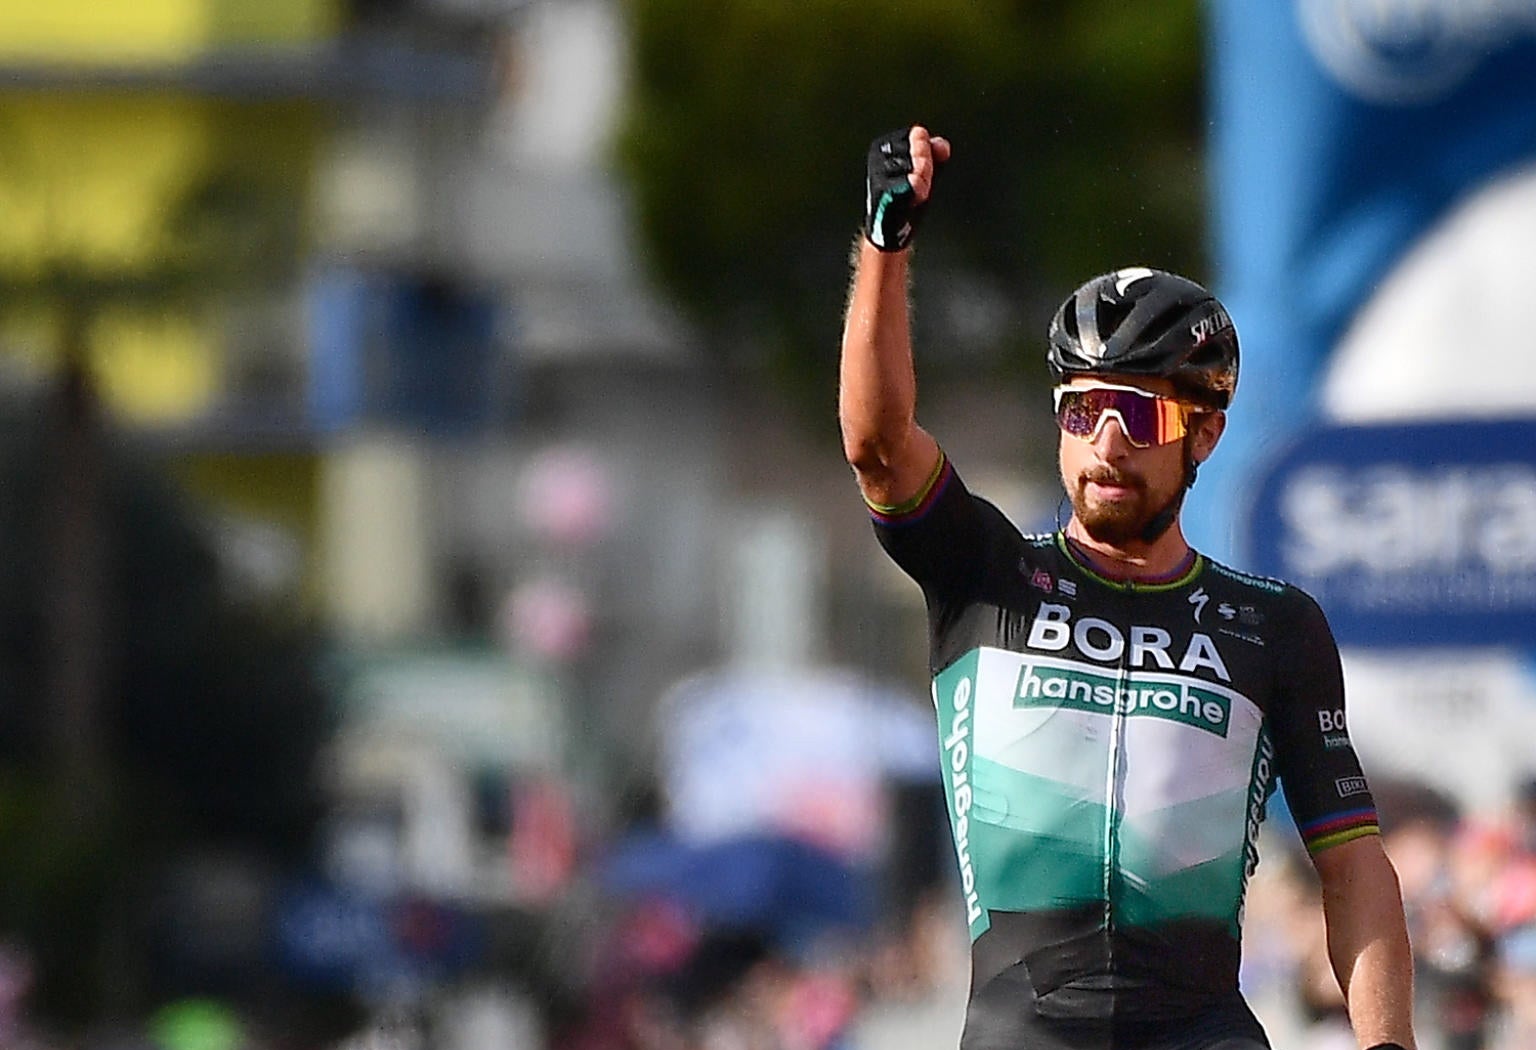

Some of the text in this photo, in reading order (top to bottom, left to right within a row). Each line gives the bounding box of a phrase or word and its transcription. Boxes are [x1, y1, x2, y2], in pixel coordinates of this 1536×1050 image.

[1027, 601, 1232, 682] BORA
[1020, 664, 1225, 723] hansgrohe
[1318, 709, 1345, 732] BO
[944, 677, 982, 926] hansgrohe
